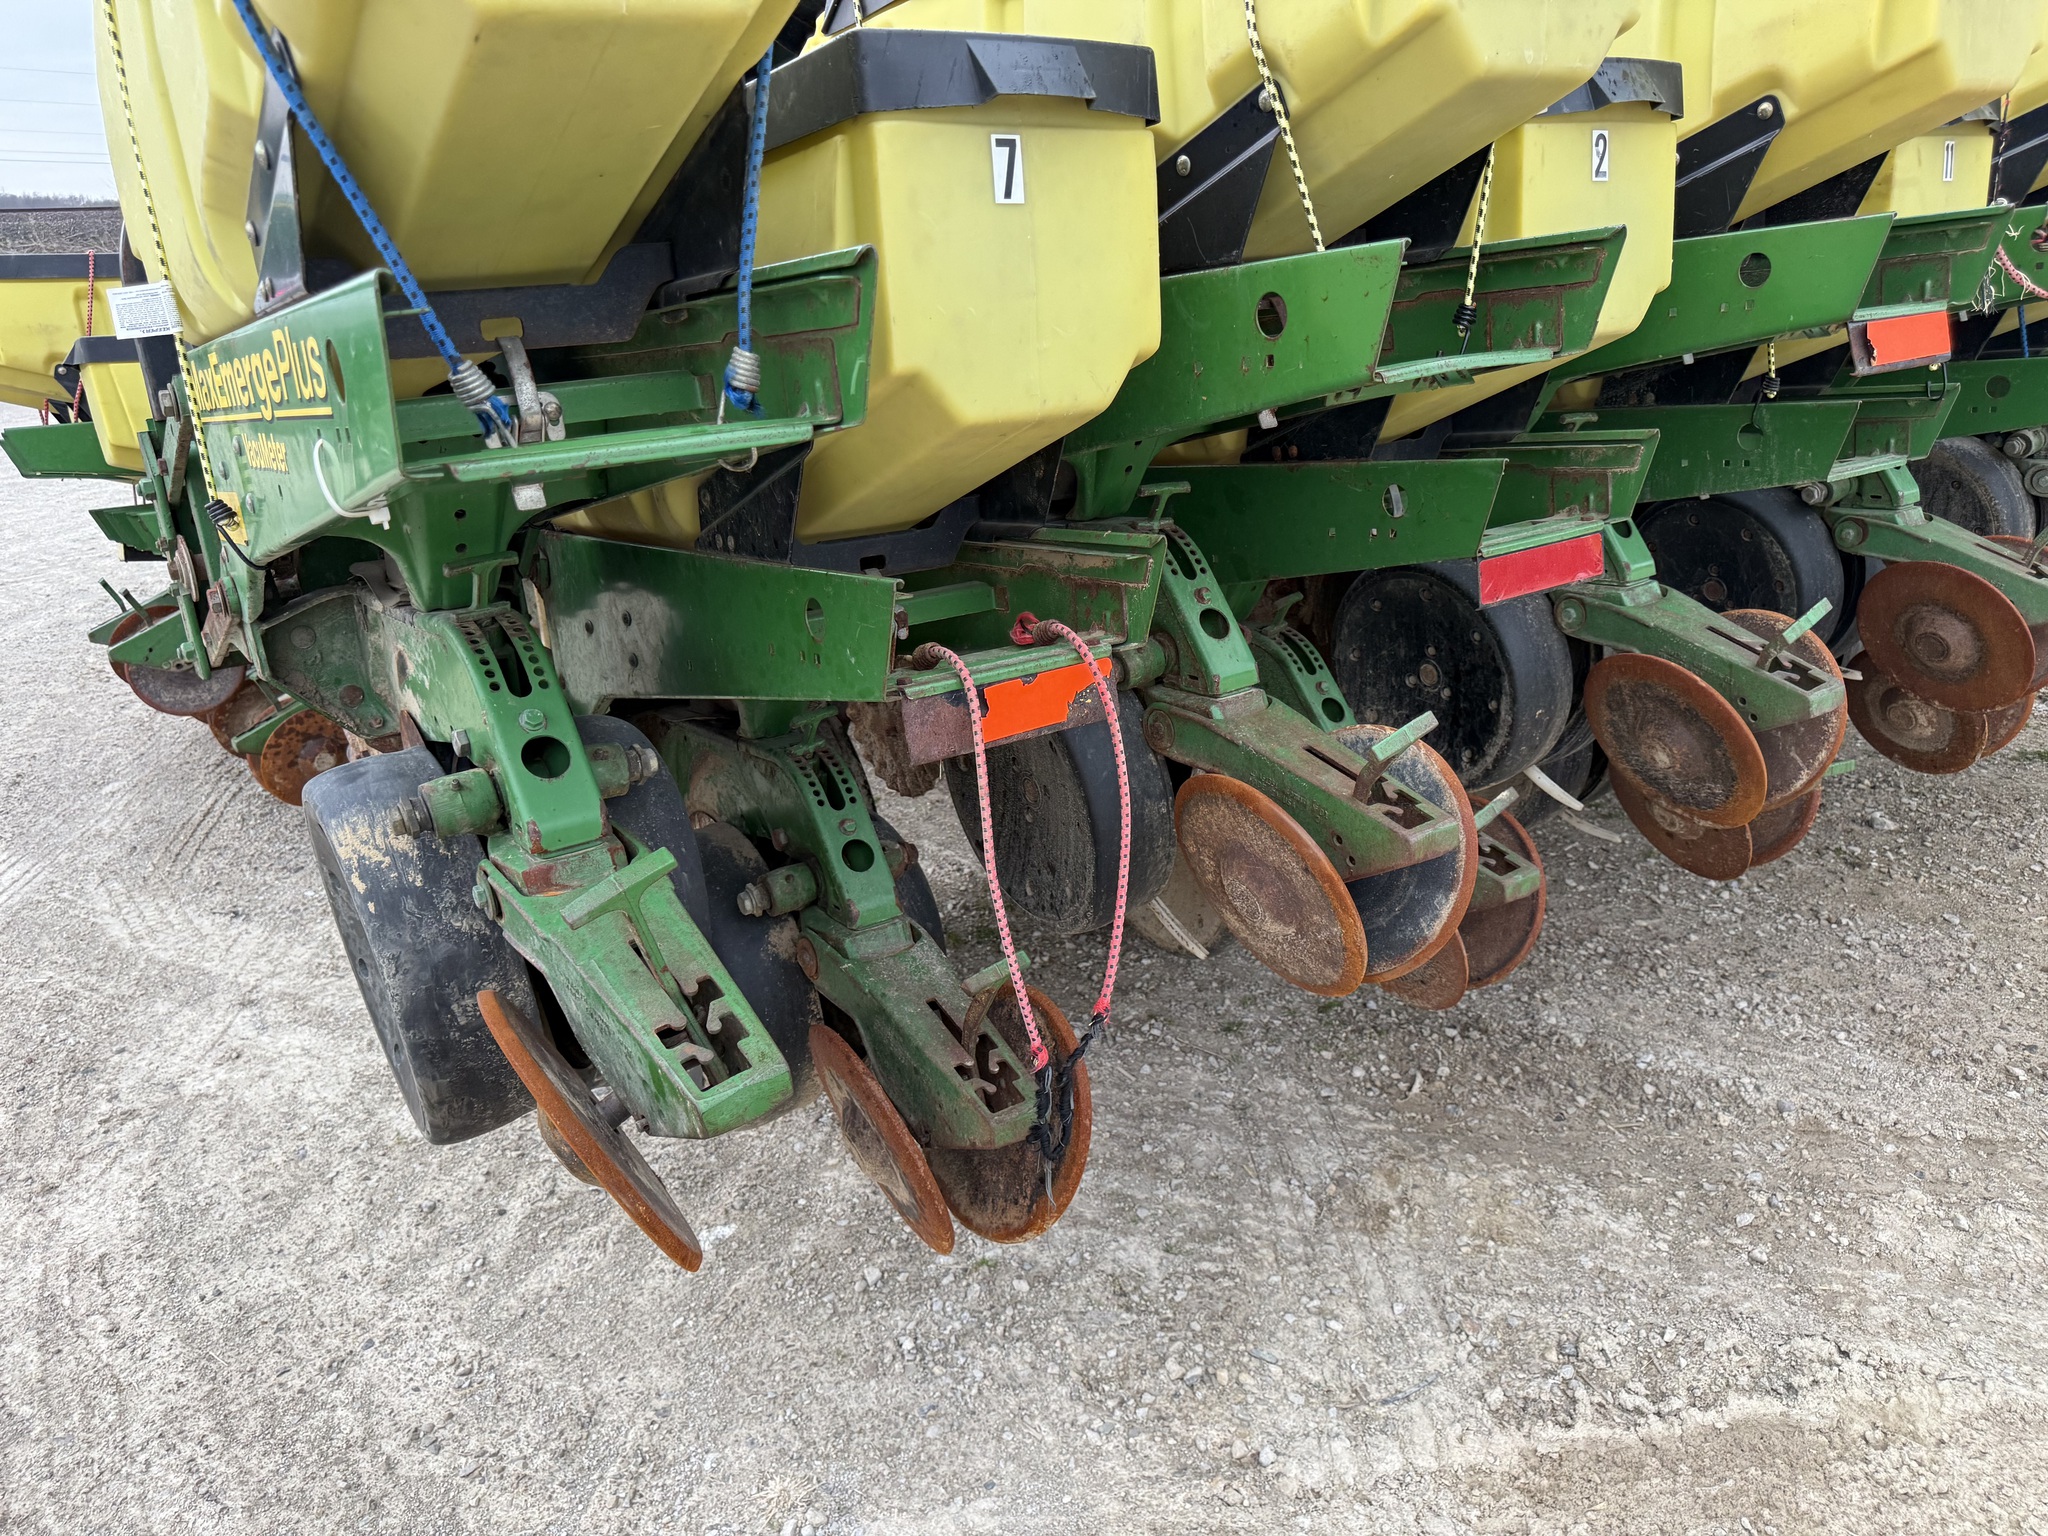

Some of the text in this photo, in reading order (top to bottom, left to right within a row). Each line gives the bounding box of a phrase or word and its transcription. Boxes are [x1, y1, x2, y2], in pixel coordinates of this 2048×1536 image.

[995, 138, 1017, 199] 7
[1595, 133, 1607, 178] 2
[241, 432, 289, 472] VacuMeter
